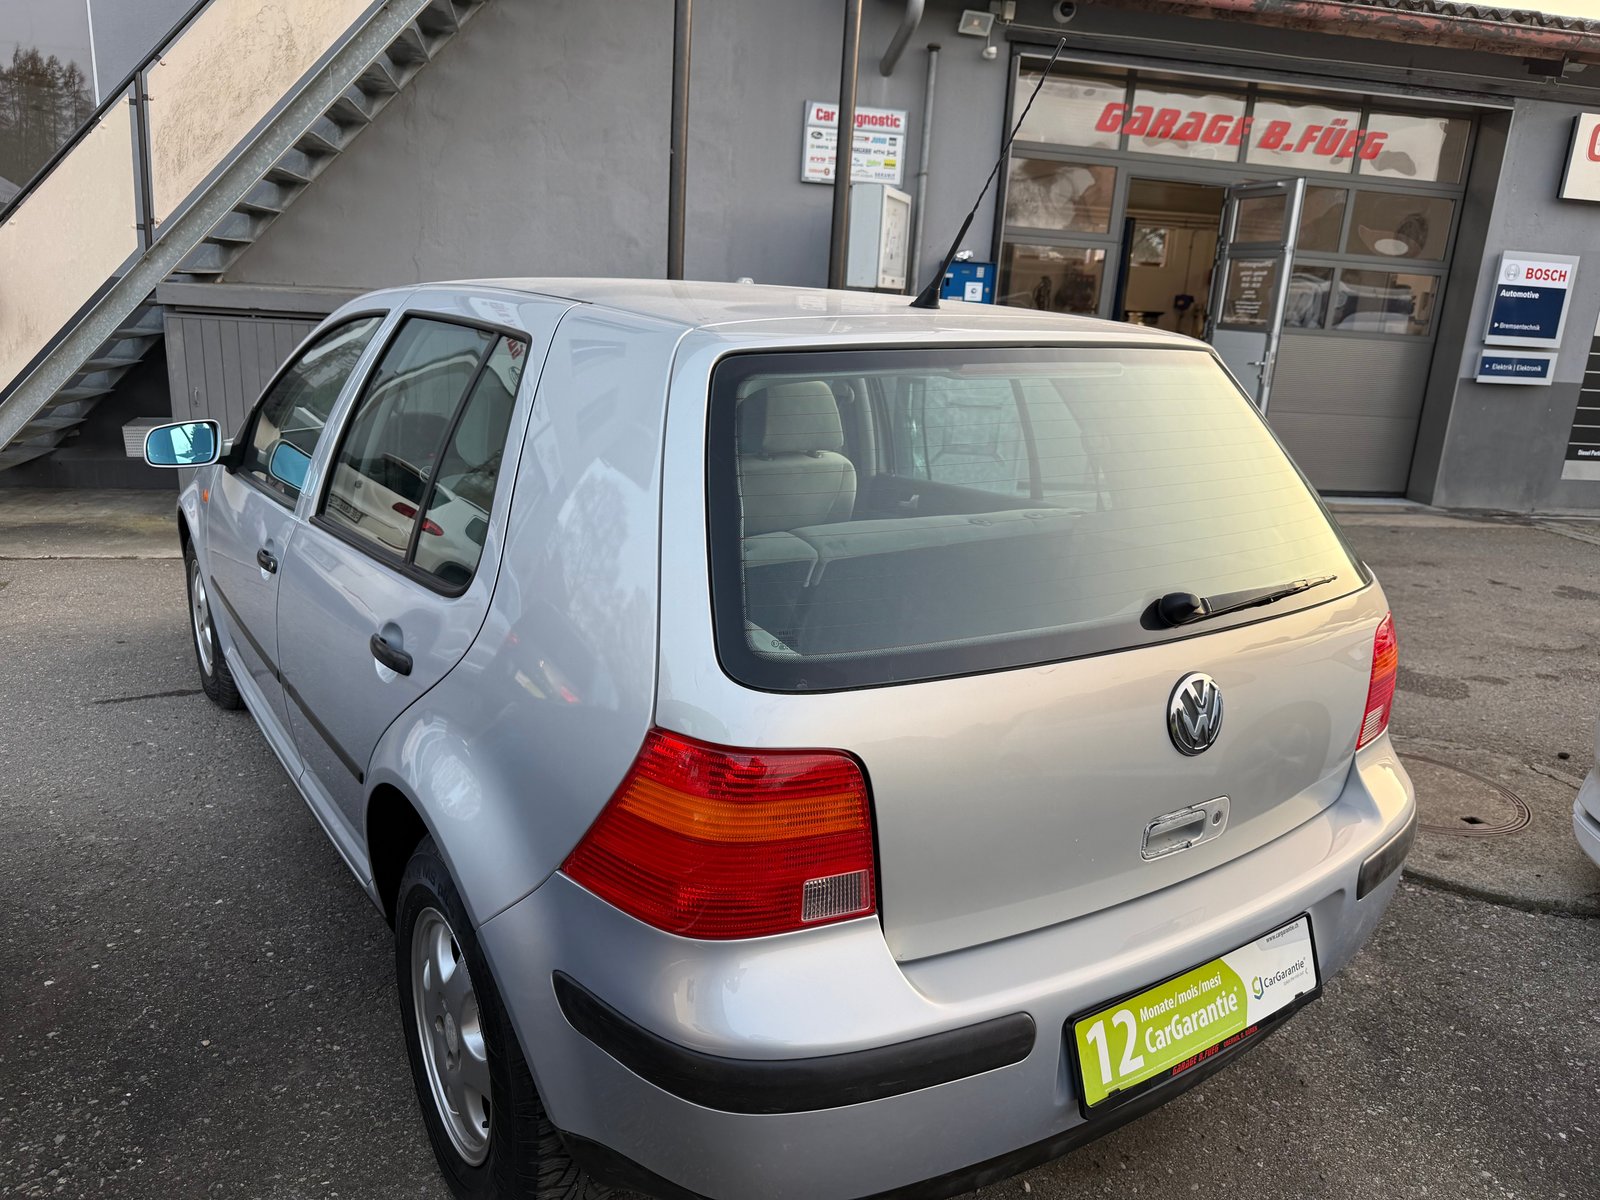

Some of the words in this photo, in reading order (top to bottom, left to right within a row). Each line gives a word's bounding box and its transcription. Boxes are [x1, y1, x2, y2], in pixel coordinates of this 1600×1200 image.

[815, 107, 836, 122] Car
[853, 112, 901, 129] gnostic
[1095, 102, 1253, 146] GARAGE
[1525, 267, 1568, 283] BOSCH
[1500, 288, 1540, 300] Automotive
[1499, 321, 1541, 332] Bremsentechnik
[1491, 362, 1513, 371] Elektrik
[1516, 363, 1542, 373] Elektronik
[1265, 922, 1300, 944] www.cargarantie.ch
[1139, 971, 1222, 1022] Monate/mois/mesi
[1085, 1008, 1145, 1085] 12
